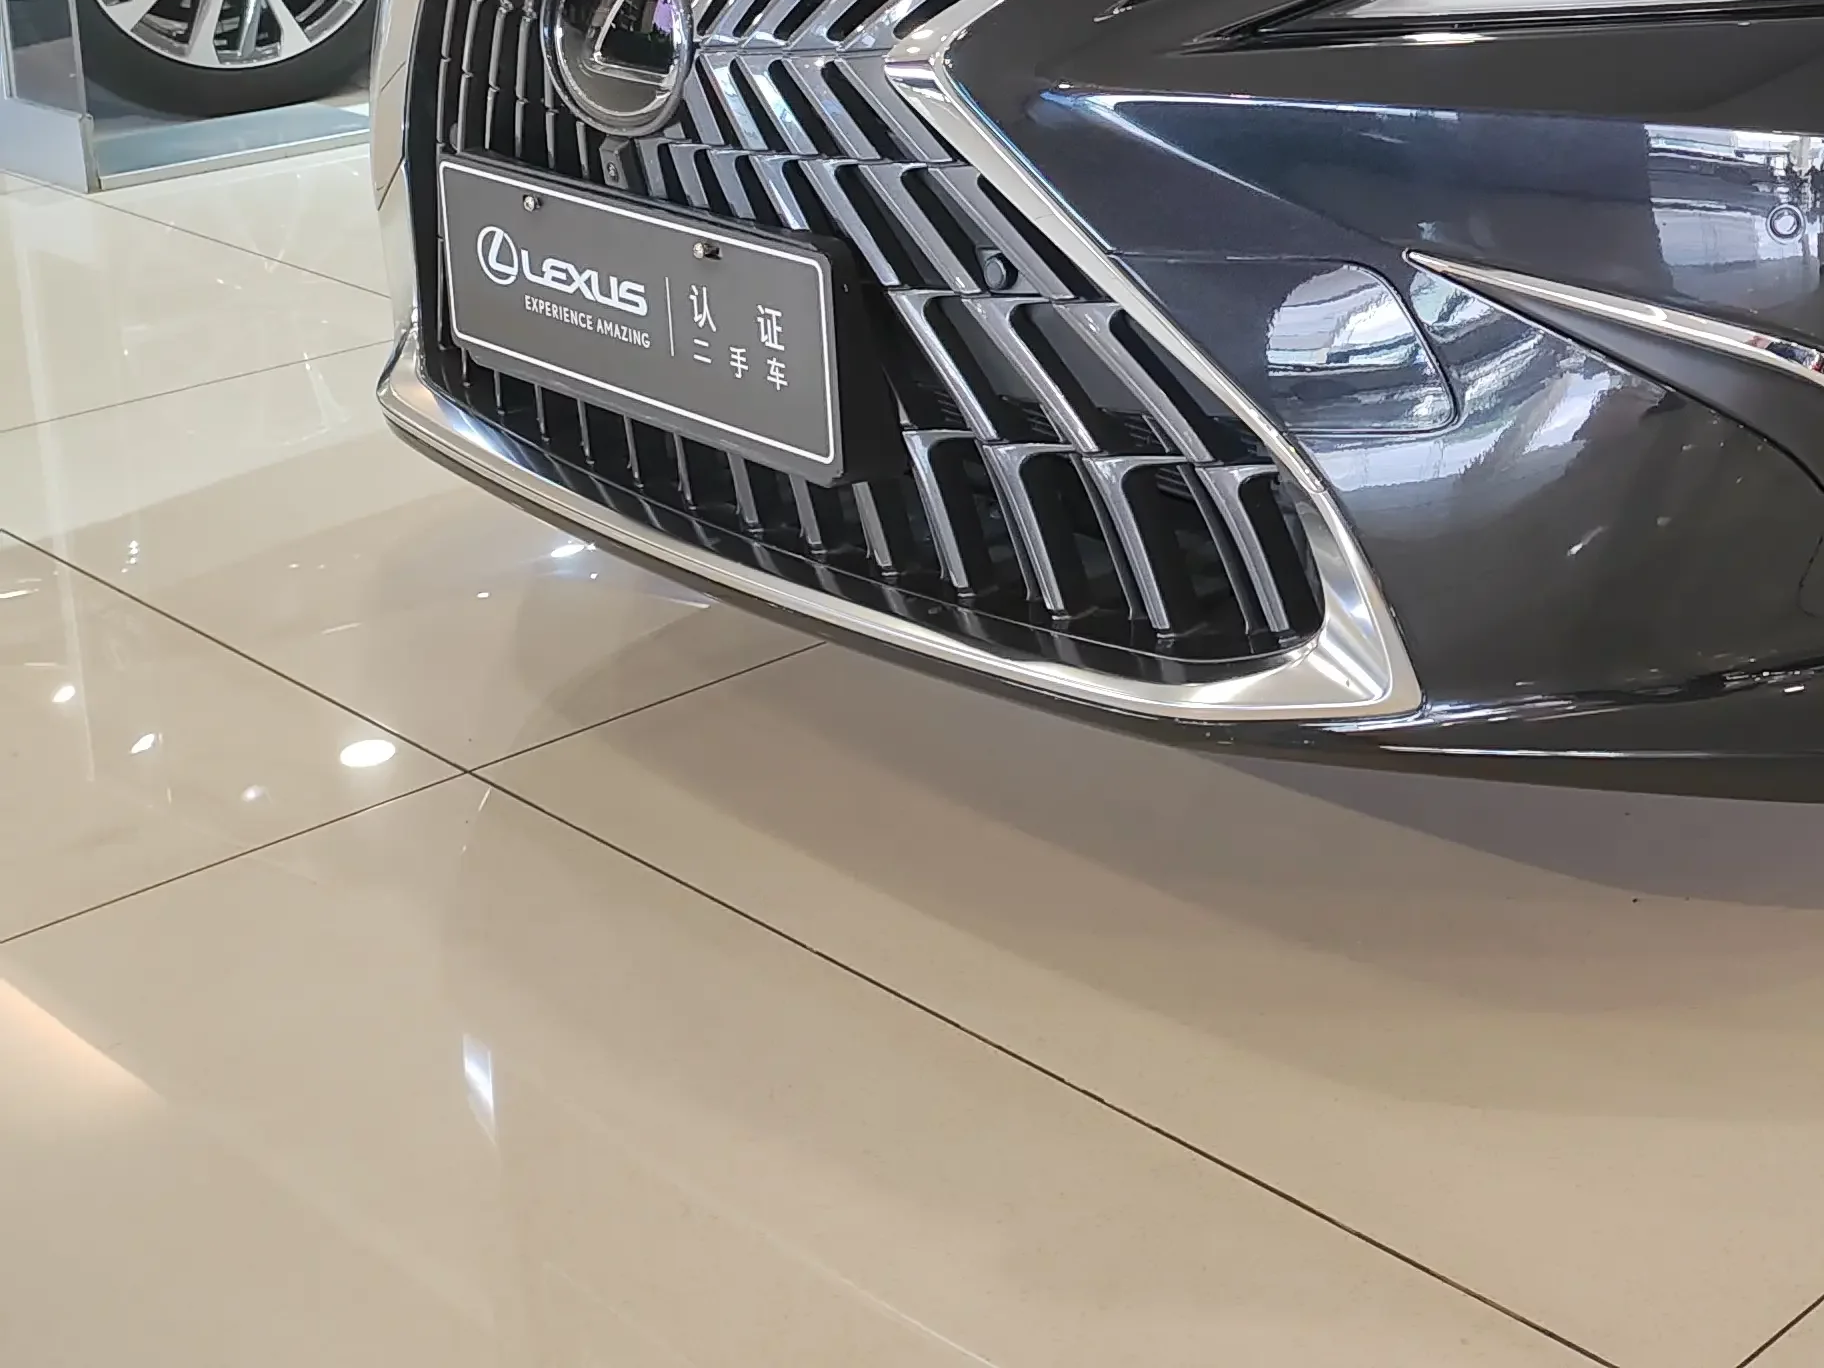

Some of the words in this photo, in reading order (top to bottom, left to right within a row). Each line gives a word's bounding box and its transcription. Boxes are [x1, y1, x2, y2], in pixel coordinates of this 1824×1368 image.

[521, 248, 648, 317] LEXUS
[524, 294, 594, 331] EXPERIENCE
[596, 317, 651, 349] AMAZING
[689, 284, 786, 352] 认证
[692, 337, 789, 391] 二手车
